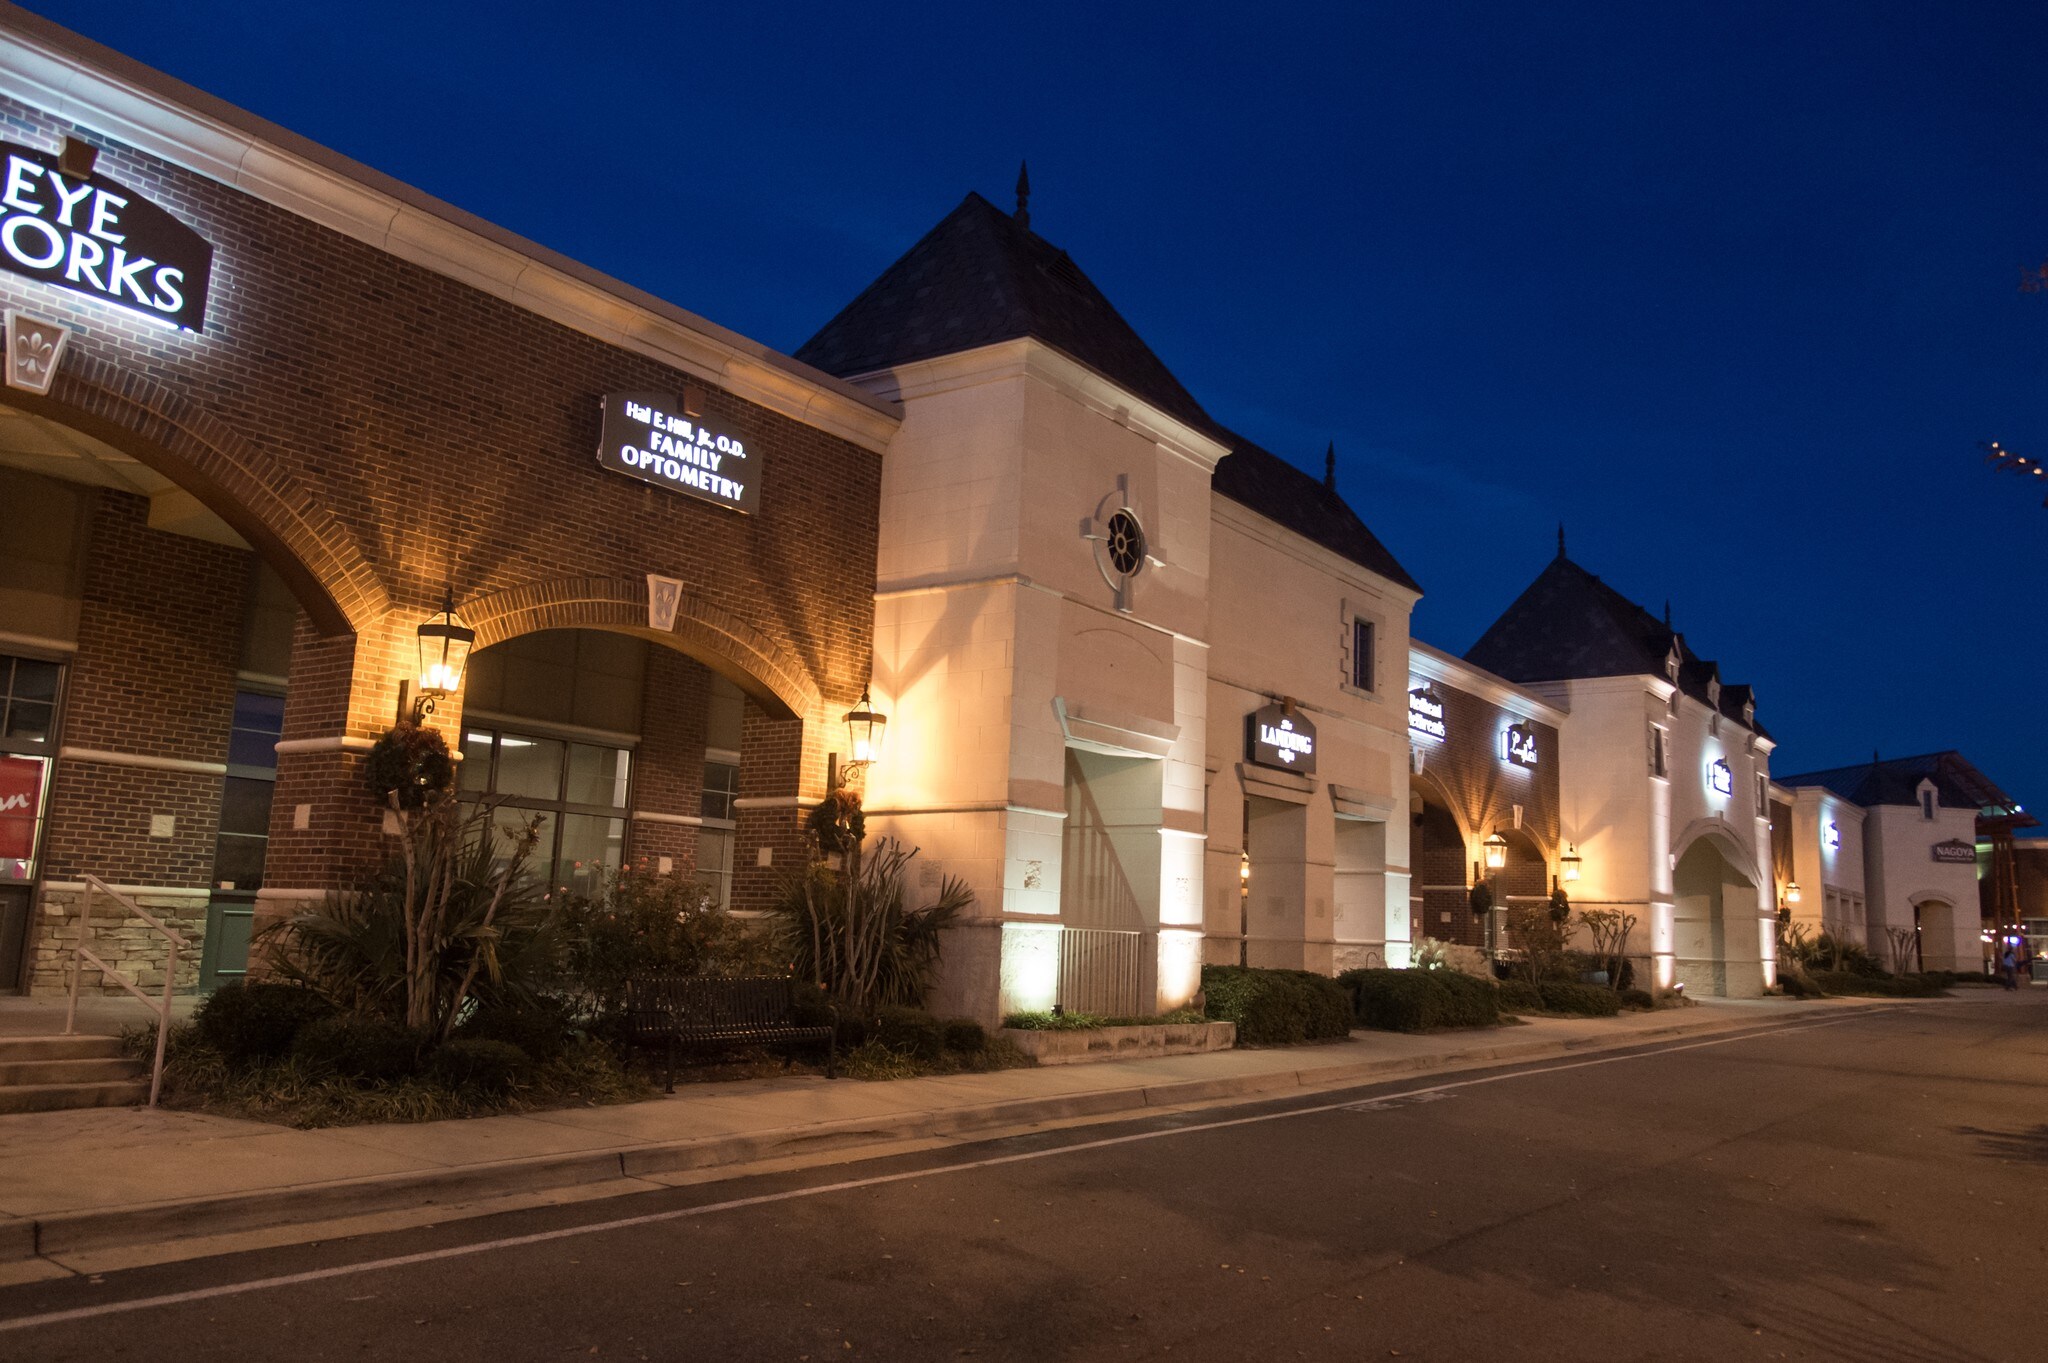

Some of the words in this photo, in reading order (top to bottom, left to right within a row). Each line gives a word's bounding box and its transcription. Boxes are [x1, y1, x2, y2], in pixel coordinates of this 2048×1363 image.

[3, 154, 128, 244] EYE
[0, 205, 184, 313] ORKS
[626, 401, 651, 424] Hal
[716, 435, 747, 459] O.D.
[651, 431, 722, 472] FAMILY
[621, 445, 745, 501] OPTOMETRY
[1261, 724, 1312, 754] LANDING
[1936, 846, 1975, 857] NAGOYA
